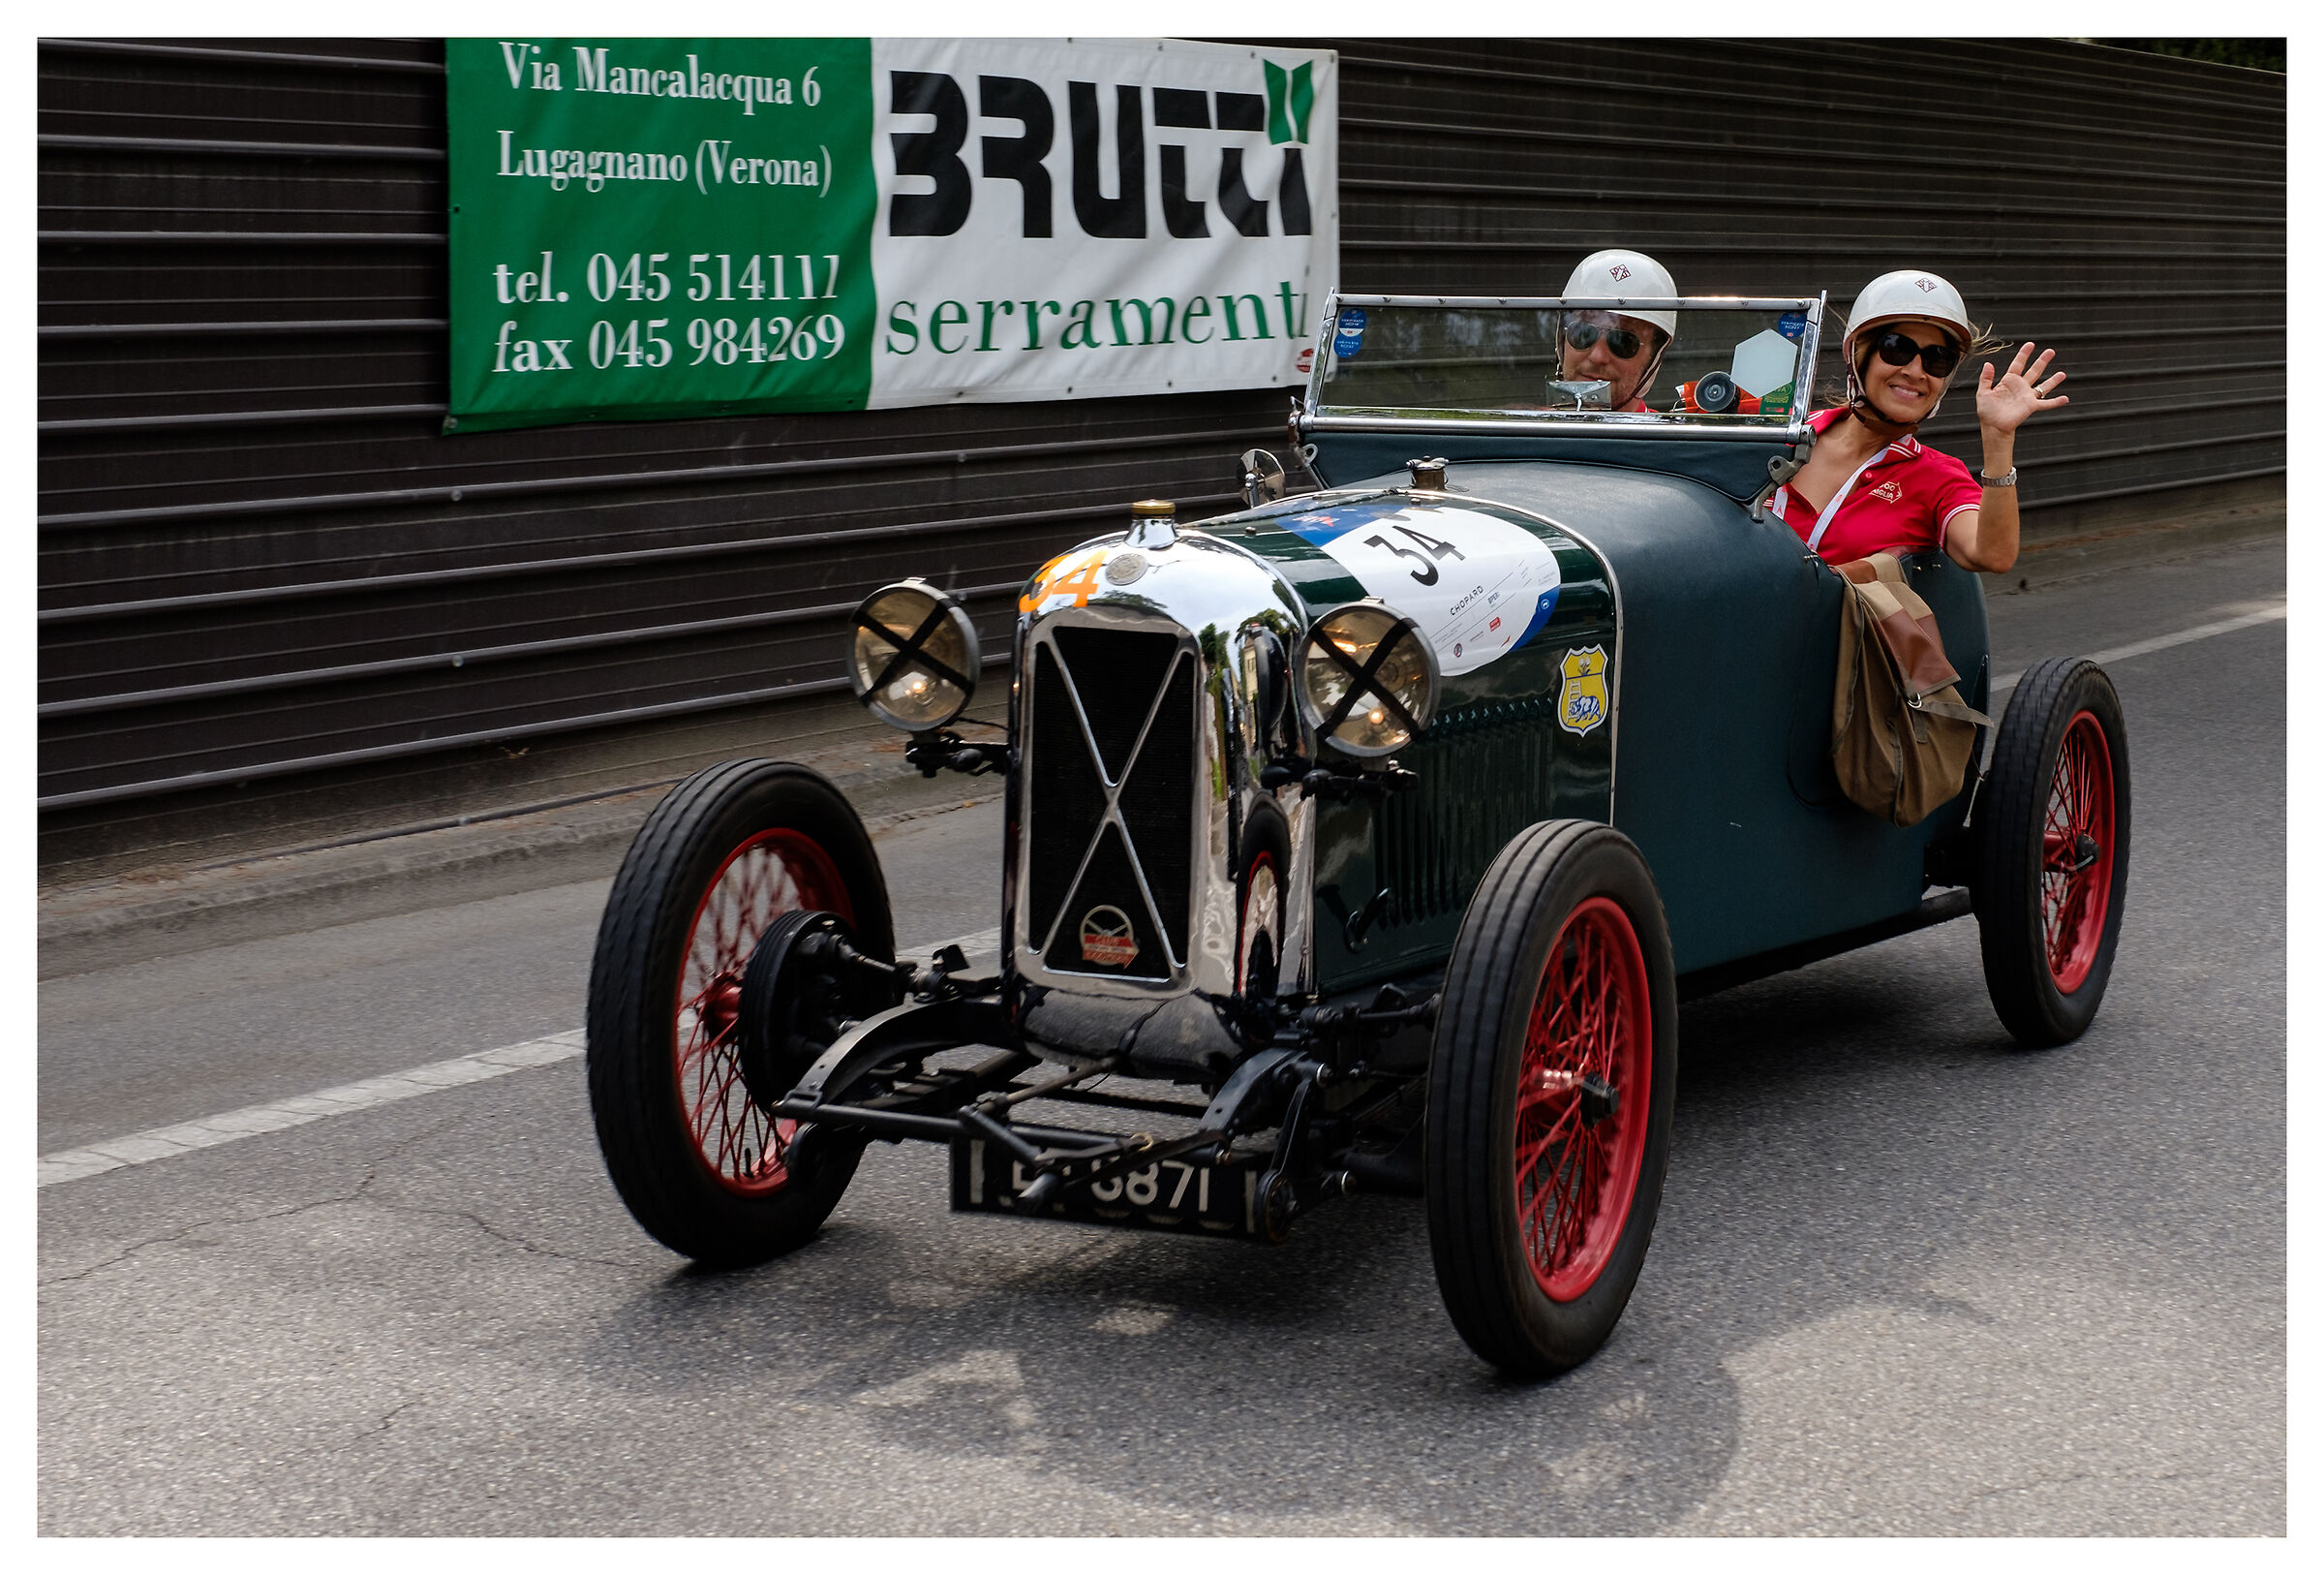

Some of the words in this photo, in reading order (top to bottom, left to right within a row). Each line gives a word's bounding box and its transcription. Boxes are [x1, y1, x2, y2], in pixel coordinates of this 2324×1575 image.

[499, 42, 563, 91] Via
[572, 46, 794, 115] Mancalacqua
[802, 66, 821, 107] 6
[496, 130, 688, 193] Lugagnano
[695, 139, 832, 199] (Verona)
[889, 59, 1314, 239] BRUTTI
[493, 251, 569, 303] tel.
[587, 252, 671, 302] 045
[687, 254, 841, 302] 514111
[492, 321, 573, 373] fax
[588, 318, 674, 370] 045
[687, 314, 845, 367] 984269
[1019, 550, 1109, 613] 34
[1363, 525, 1466, 586] 34
[1450, 585, 1484, 616] CHOPARD
